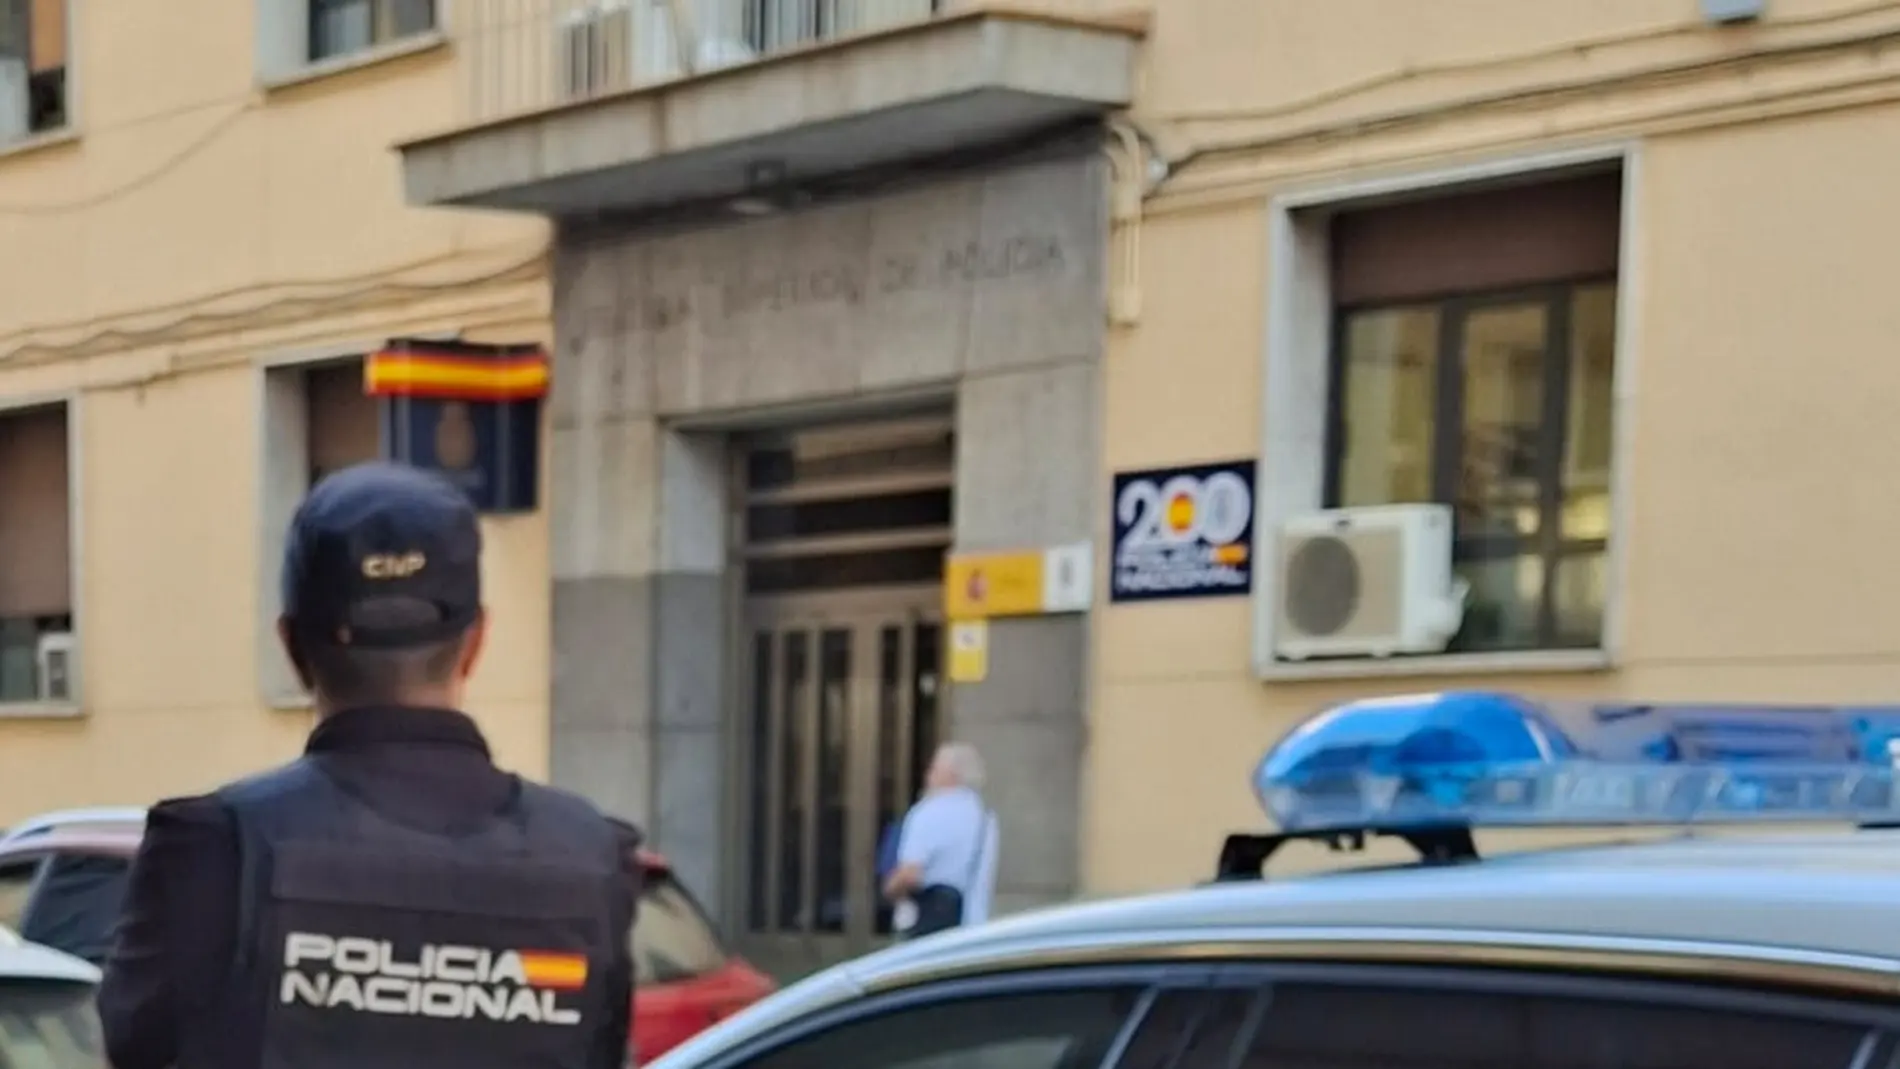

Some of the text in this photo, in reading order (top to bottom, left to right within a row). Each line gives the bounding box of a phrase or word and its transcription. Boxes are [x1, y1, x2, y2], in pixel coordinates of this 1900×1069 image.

[1117, 471, 1251, 548] 200
[361, 551, 427, 579] CNP
[284, 931, 527, 985] POLICIA
[280, 970, 581, 1025] NACIONAL
